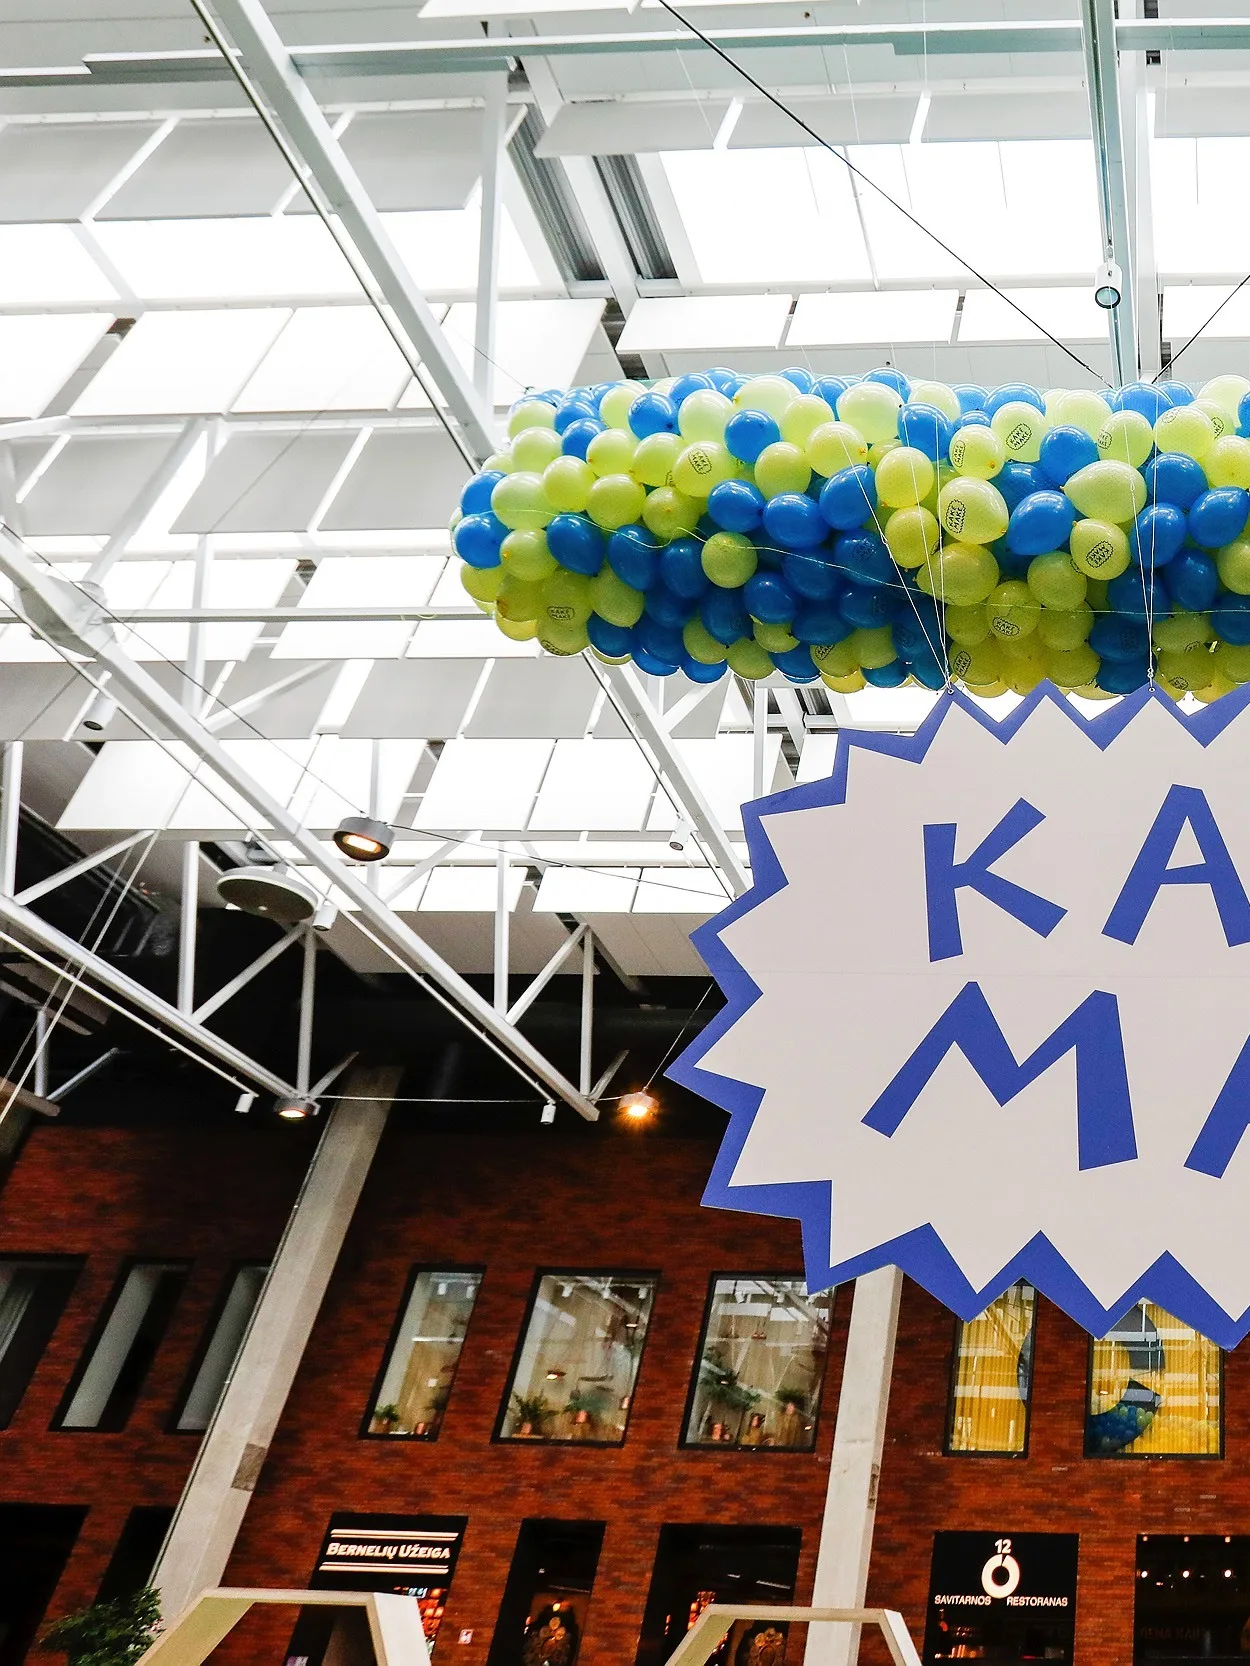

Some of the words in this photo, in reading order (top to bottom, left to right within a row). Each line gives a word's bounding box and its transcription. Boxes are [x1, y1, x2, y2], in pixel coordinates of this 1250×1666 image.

[995, 1539, 1012, 1553] 12
[934, 1594, 992, 1606] SAVITARNOS
[1006, 1596, 1068, 1607] RESTORANAS
